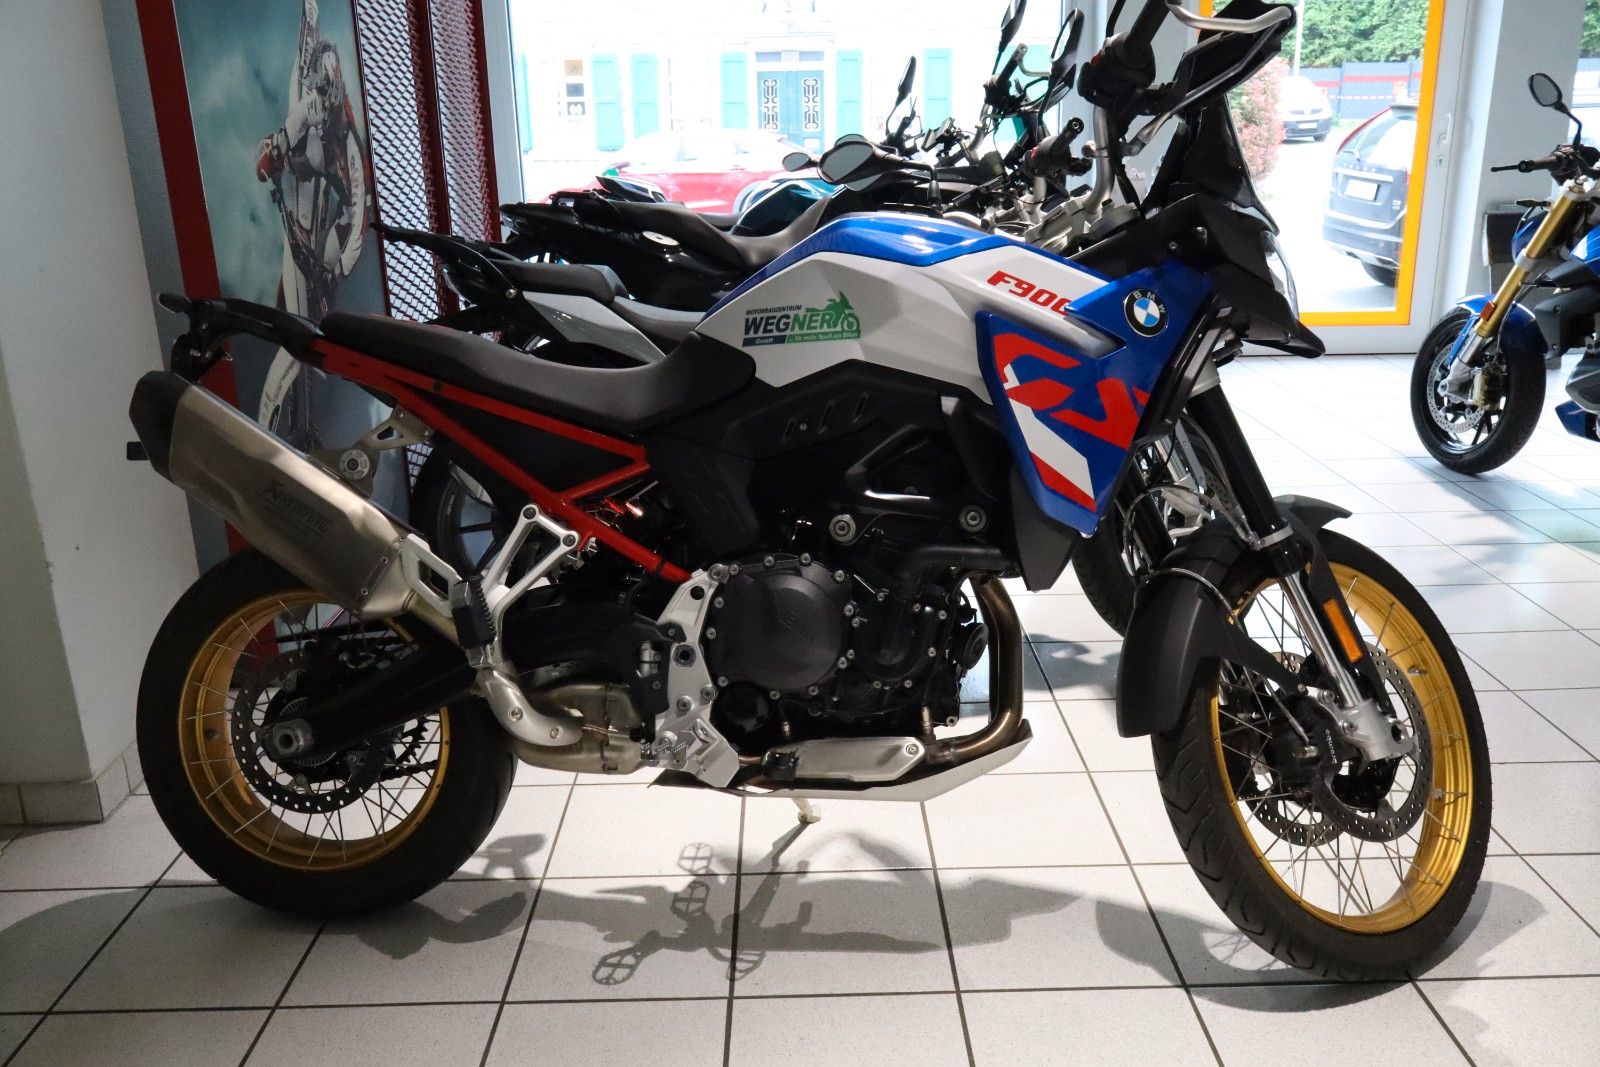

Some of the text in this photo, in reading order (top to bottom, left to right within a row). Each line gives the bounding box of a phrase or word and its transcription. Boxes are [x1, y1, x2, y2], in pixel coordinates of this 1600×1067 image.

[745, 304, 803, 315] MOTORRADZENTRUM
[744, 312, 835, 336] WEGNER
[755, 337, 774, 345] GmbH
